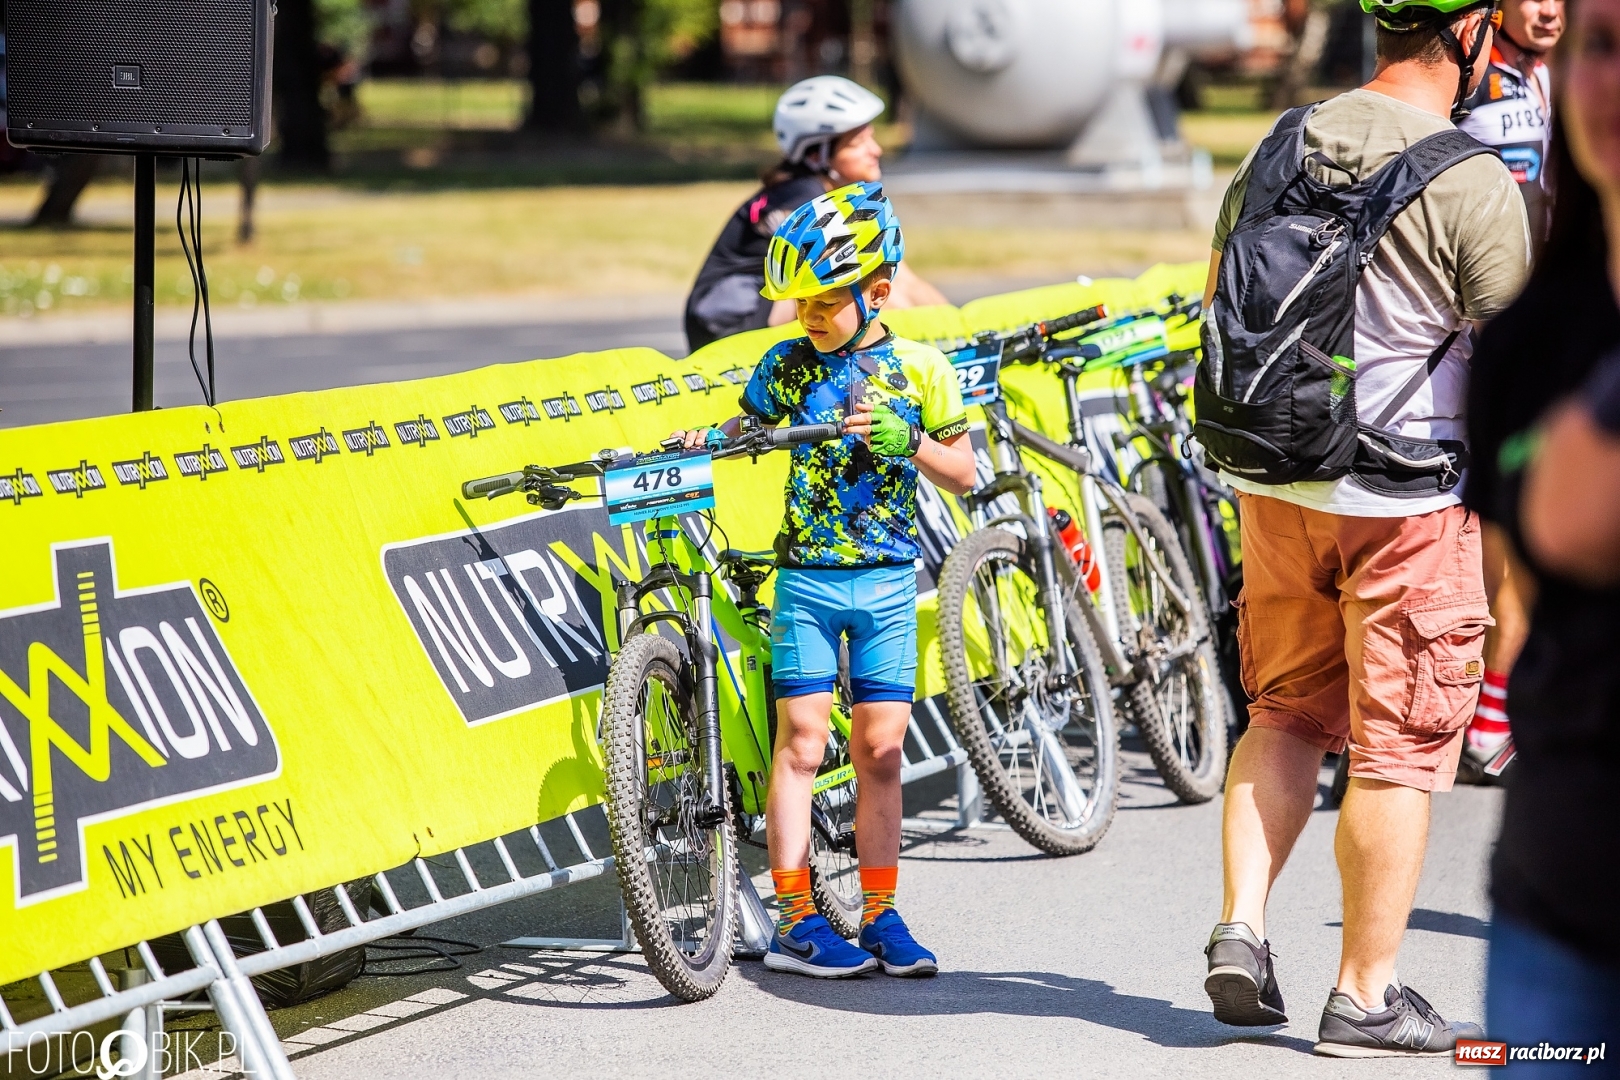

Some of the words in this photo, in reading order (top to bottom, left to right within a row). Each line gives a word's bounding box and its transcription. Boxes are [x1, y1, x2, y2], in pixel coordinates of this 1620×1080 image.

[633, 467, 682, 492] 478
[103, 833, 163, 899] MY
[169, 798, 304, 879] ENERGY
